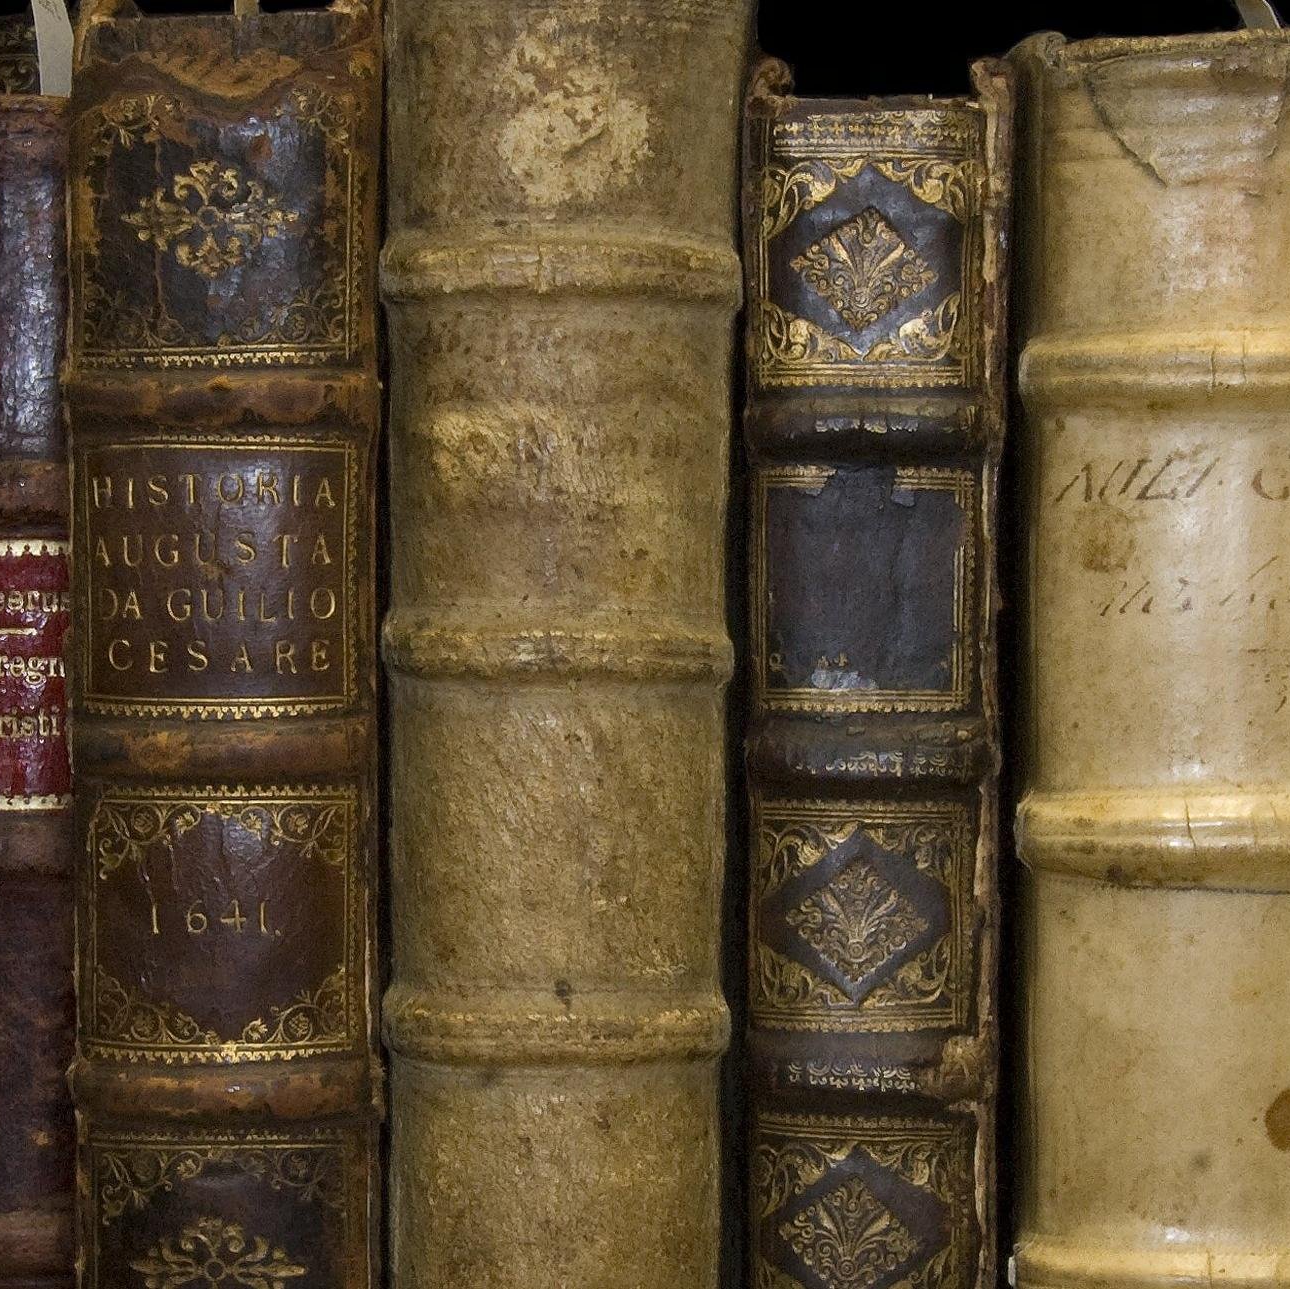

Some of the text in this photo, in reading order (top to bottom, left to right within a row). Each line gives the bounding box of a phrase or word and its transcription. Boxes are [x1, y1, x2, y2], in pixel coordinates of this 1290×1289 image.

[92, 474, 336, 509] HISTORIA
[94, 532, 332, 567] AUGUSTA
[166, 587, 337, 623] GUILIO
[108, 638, 332, 675] CESARE
